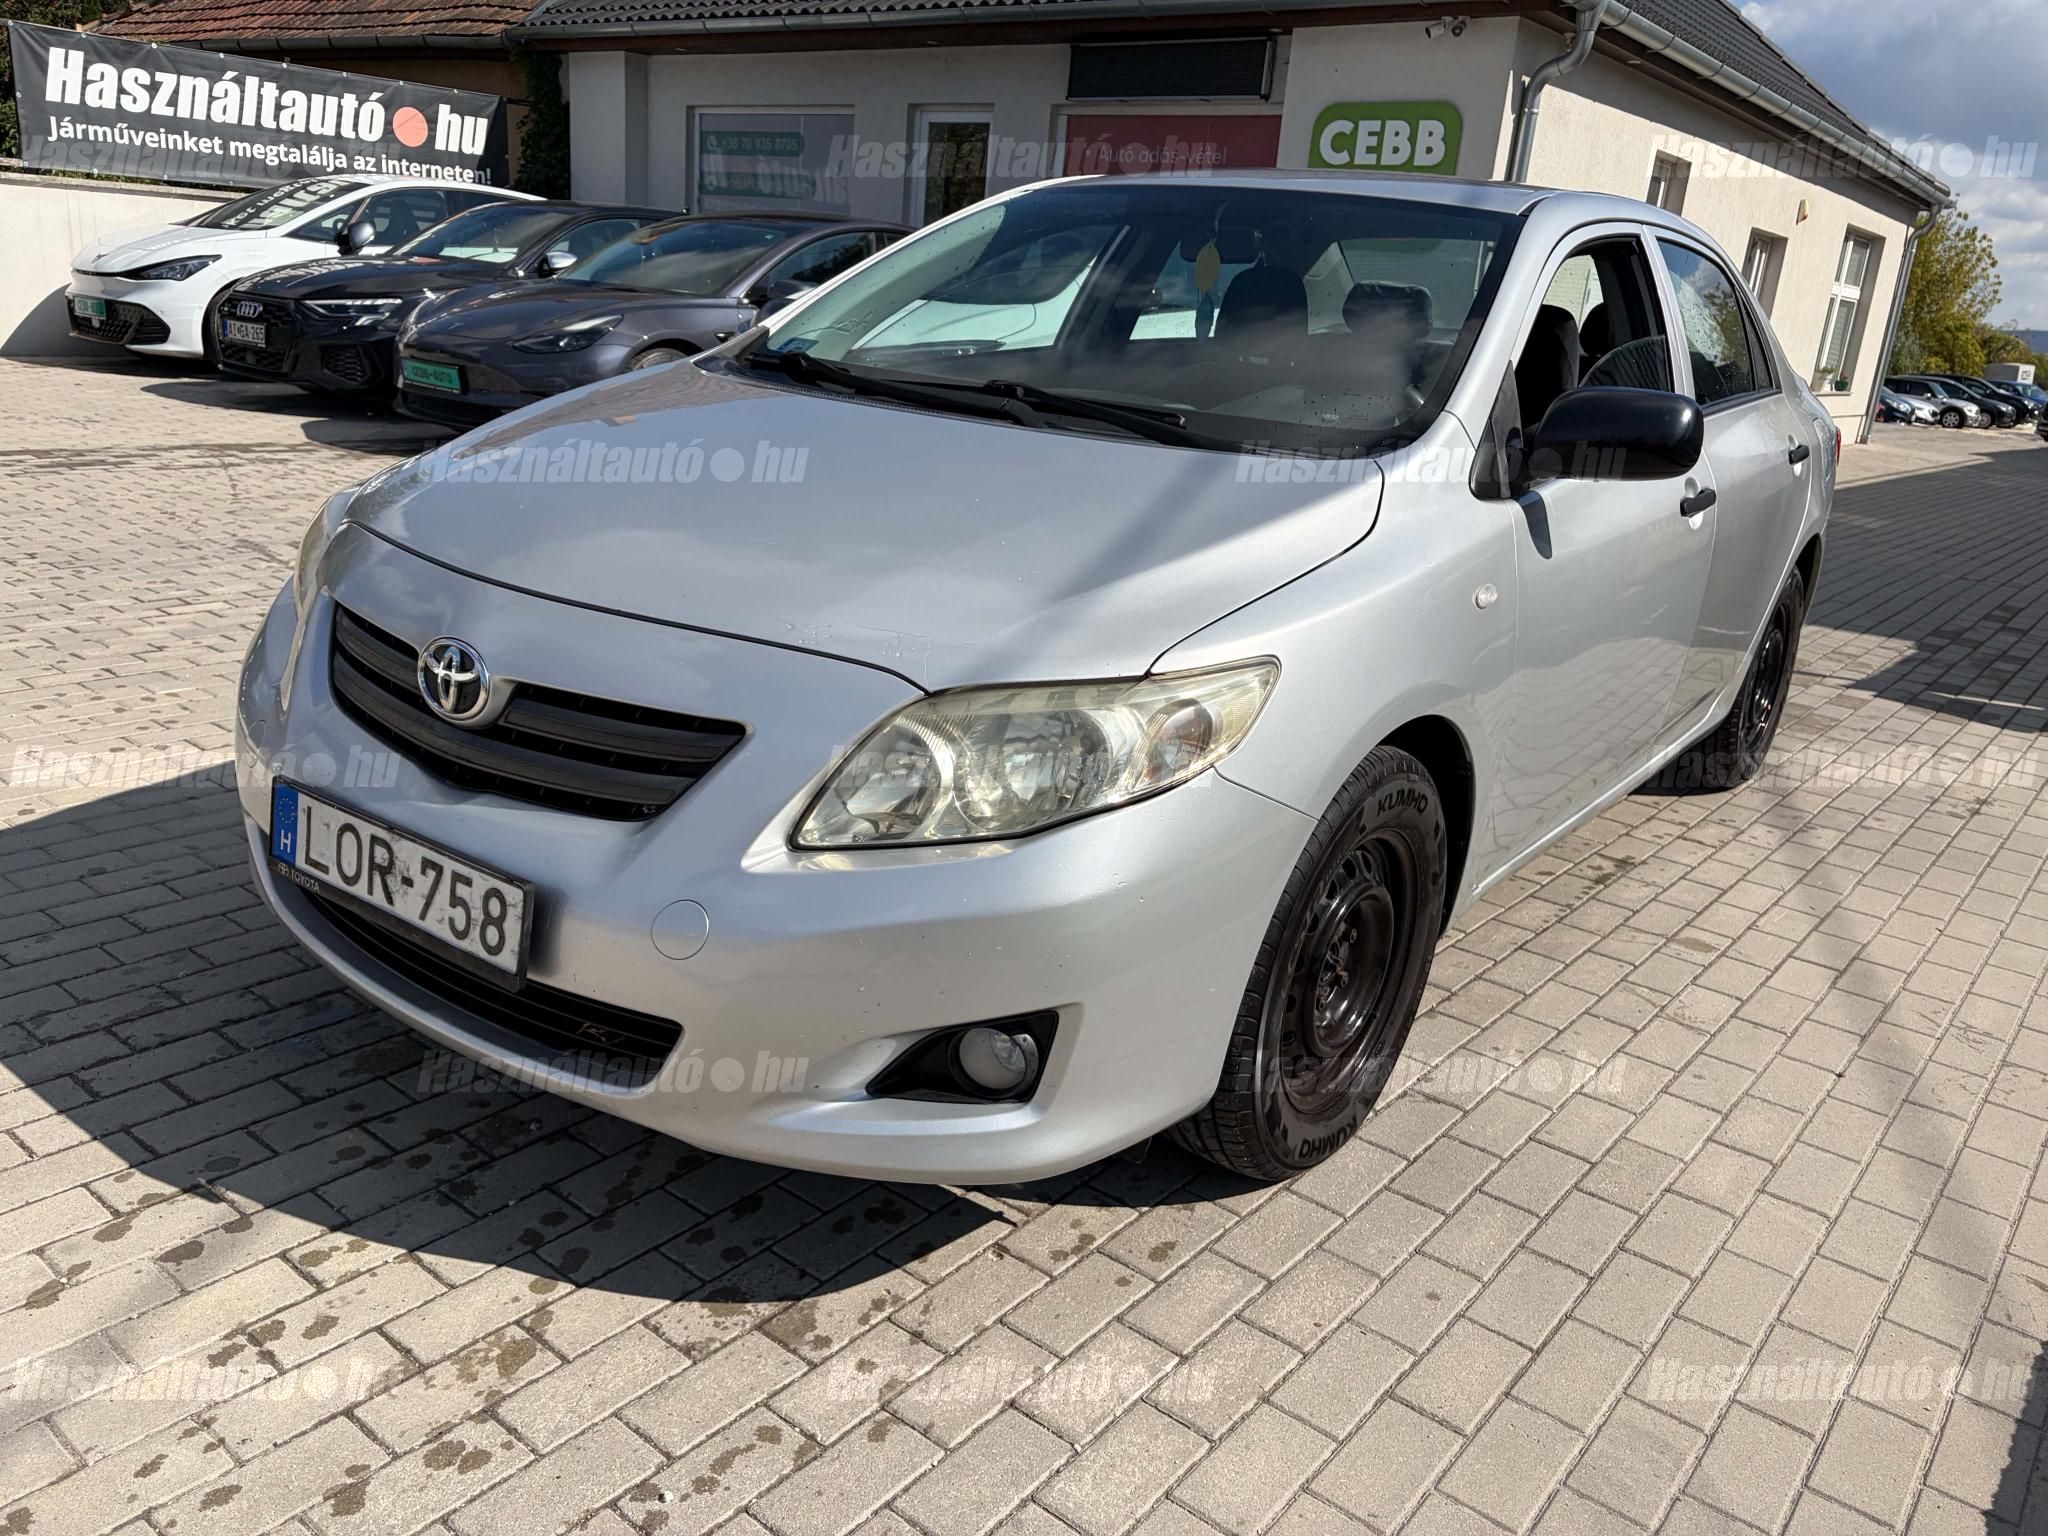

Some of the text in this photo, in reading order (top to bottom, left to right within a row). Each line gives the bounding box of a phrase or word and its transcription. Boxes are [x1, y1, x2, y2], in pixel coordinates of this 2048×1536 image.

[48, 115, 491, 185] Járműveinket megtalálja az interneten!
[1099, 144, 1136, 163] Autó
[1319, 119, 1446, 167] CEBB
[1376, 787, 1428, 817] KUMHO
[279, 829, 292, 854] H
[291, 869, 321, 894] TOYOTA
[304, 806, 507, 956] LOR-758
